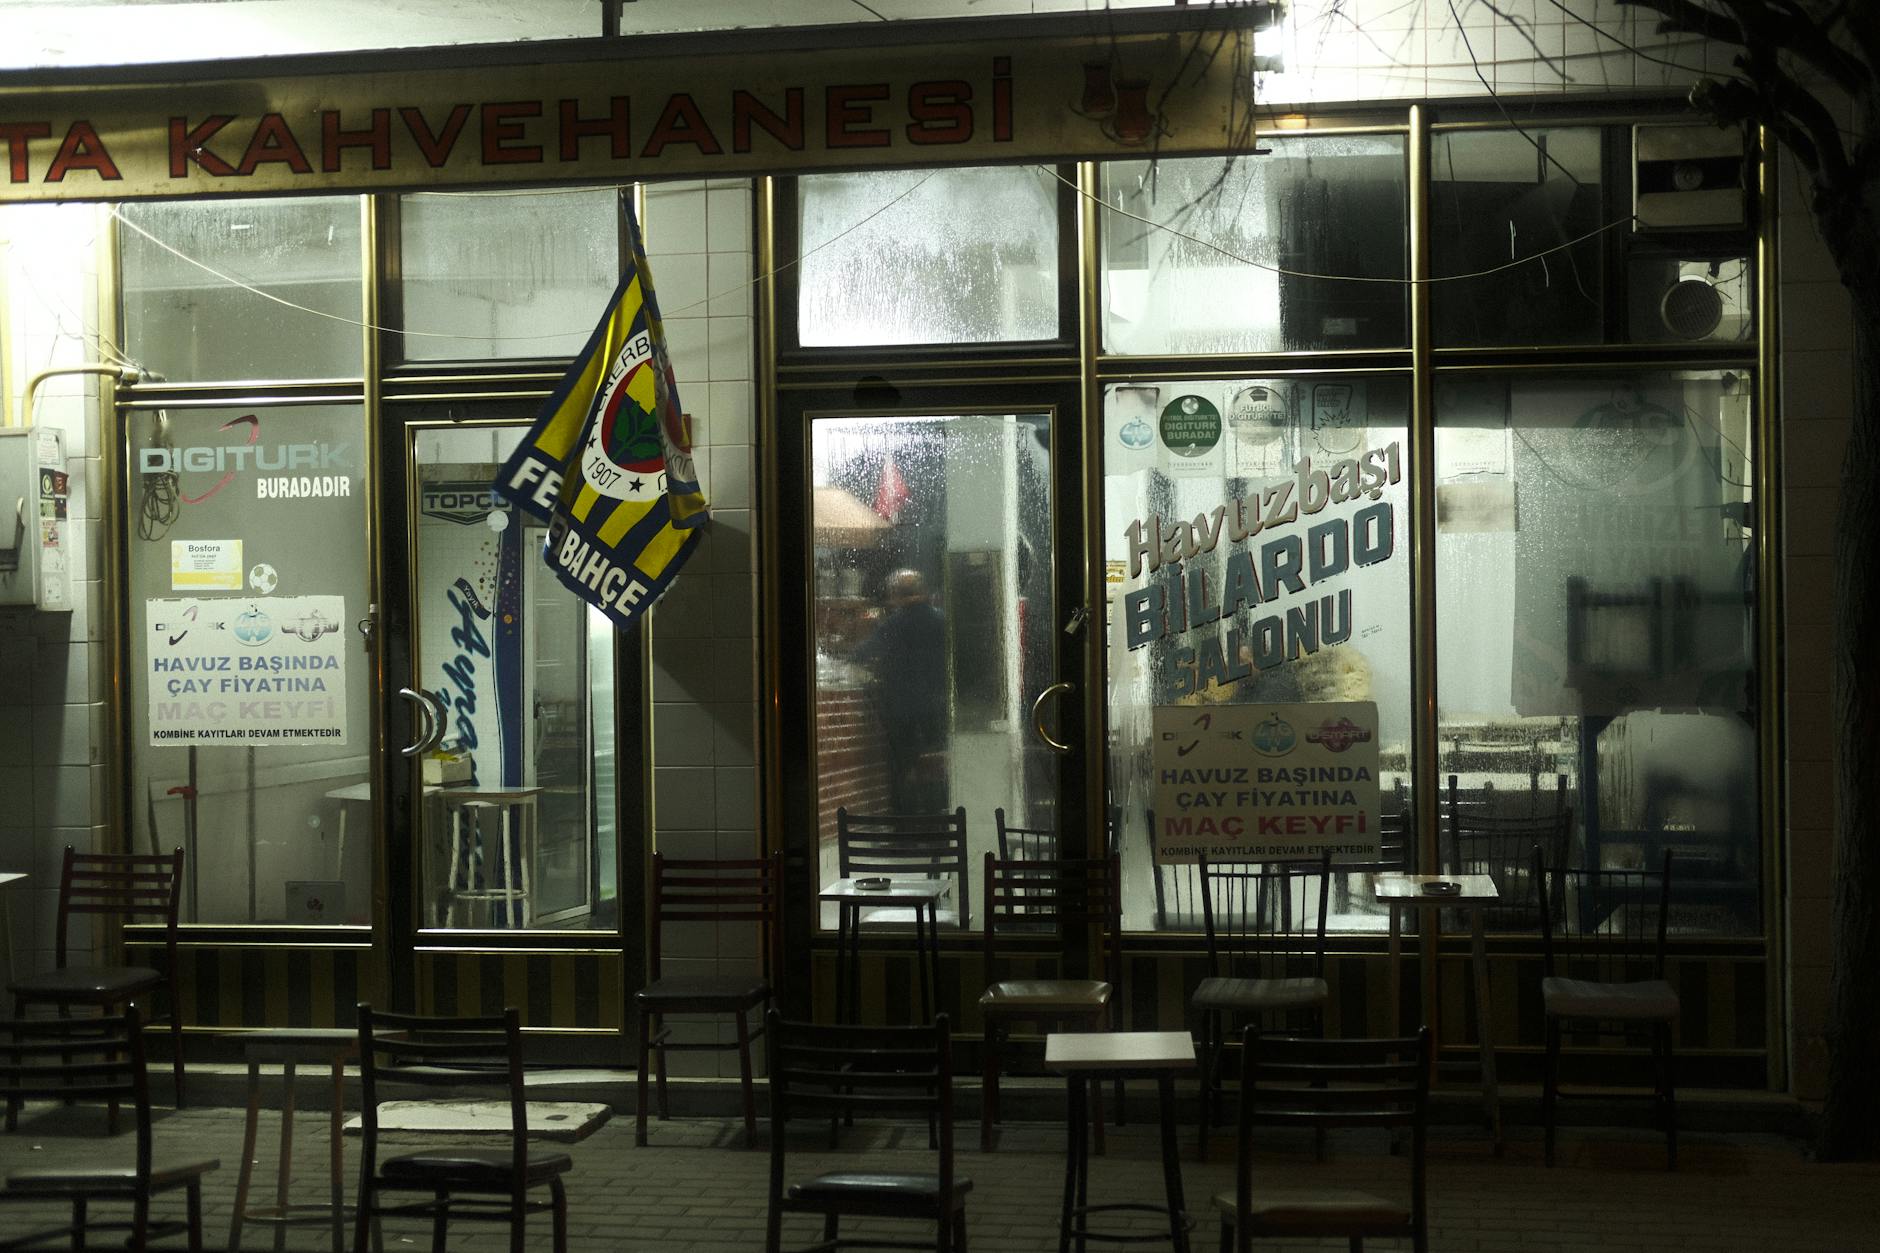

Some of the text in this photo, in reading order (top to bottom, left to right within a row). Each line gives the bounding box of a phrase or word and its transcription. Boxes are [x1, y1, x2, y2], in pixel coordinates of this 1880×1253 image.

[0, 56, 1014, 183] TA KAHVEHANESİ
[1167, 431, 1215, 439] BURADA!
[139, 442, 350, 474] DIGITURK
[587, 456, 621, 489] 1907
[256, 476, 350, 499] BURADADIR
[1124, 441, 1401, 579] Havuzbaşı
[188, 544, 221, 552] Bosfora
[1125, 502, 1393, 651] BİLARDO
[1166, 588, 1352, 699] SALONU
[154, 655, 339, 674] HAVUZ BAŞINDA
[167, 675, 326, 697] ÇAY FİYATINA
[157, 697, 335, 724] MAÇ KEYFİ
[153, 726, 341, 739] KOMBİNE KAYITLARI DEVAM ETMEKTEDİR
[1161, 766, 1371, 787] HAVUZ BAŞINDA
[1176, 788, 1357, 811] ÇAY FİYATINA
[1165, 811, 1367, 840] MAÇ KEYFİ
[1161, 845, 1209, 857] KOMBİNE
[1211, 845, 1266, 856] KAYITLARI
[1269, 845, 1305, 856] DEVAM
